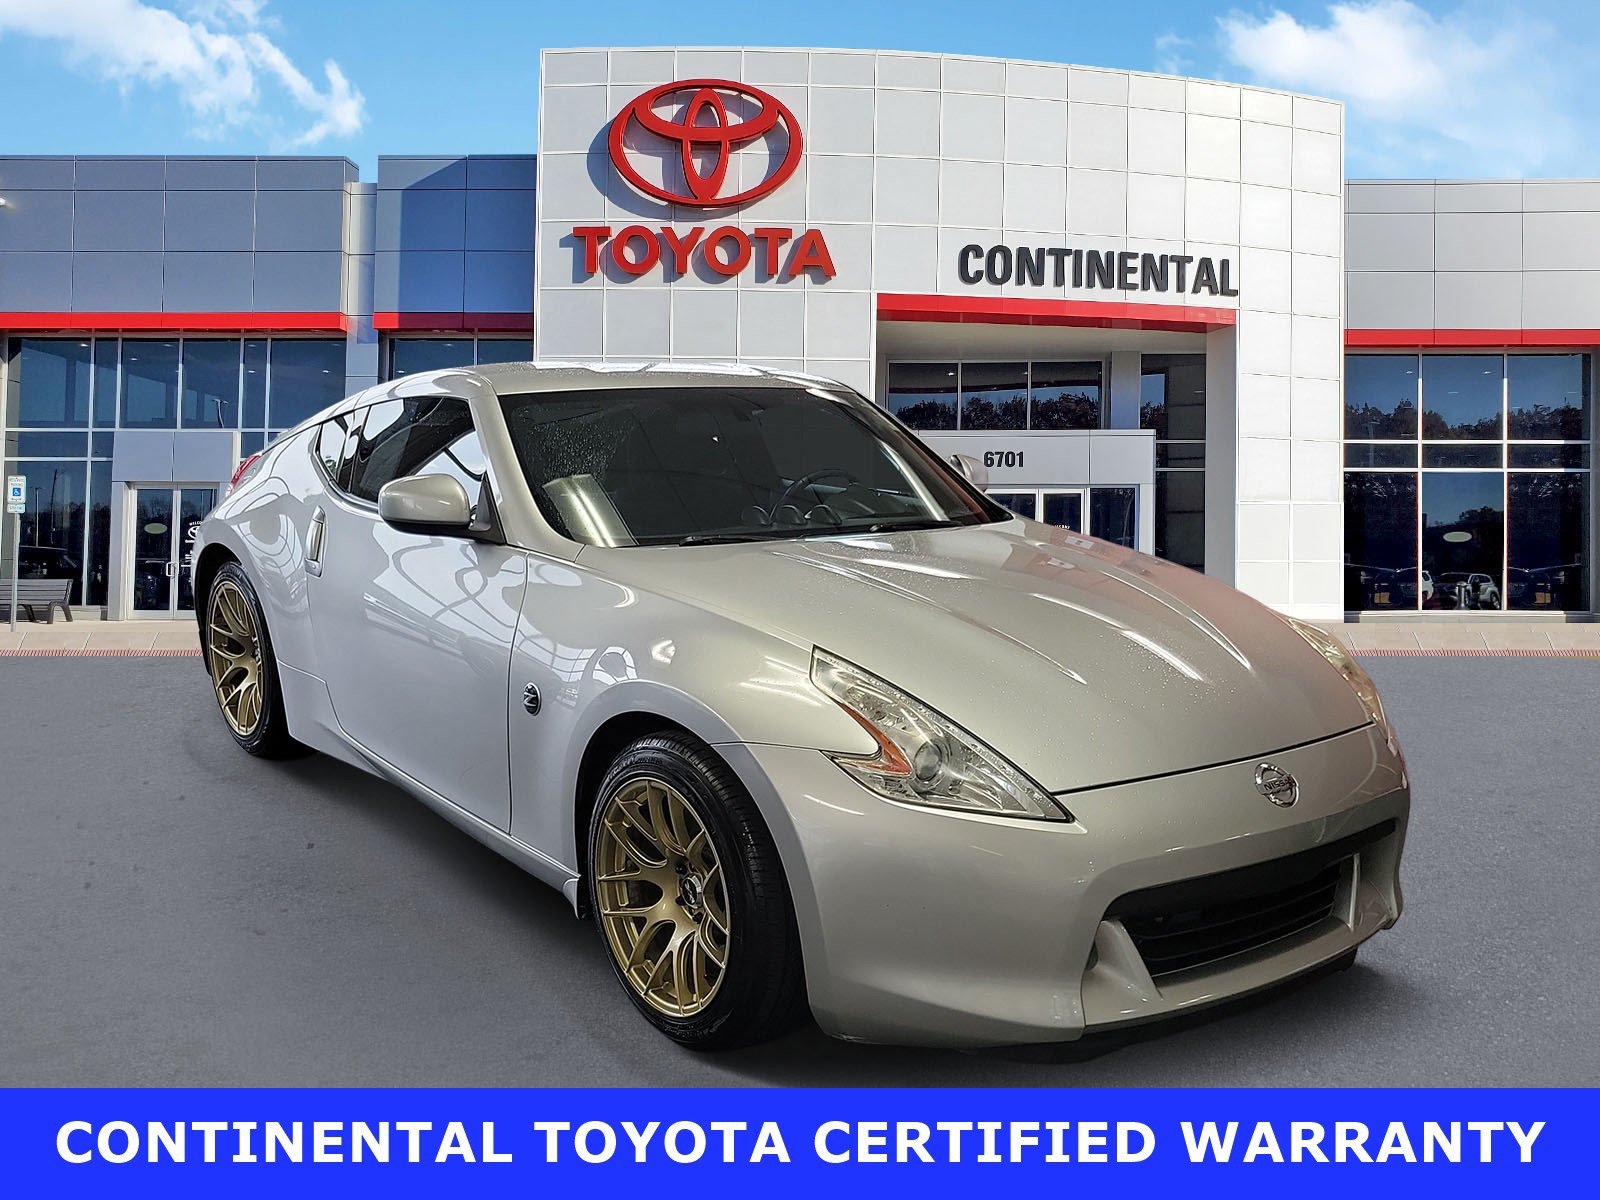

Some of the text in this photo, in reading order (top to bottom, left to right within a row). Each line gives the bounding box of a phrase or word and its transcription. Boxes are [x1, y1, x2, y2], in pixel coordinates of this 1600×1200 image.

[573, 226, 836, 277] TOYOTA
[959, 244, 1239, 297] CONTINENTAL
[984, 451, 1024, 468] 6701
